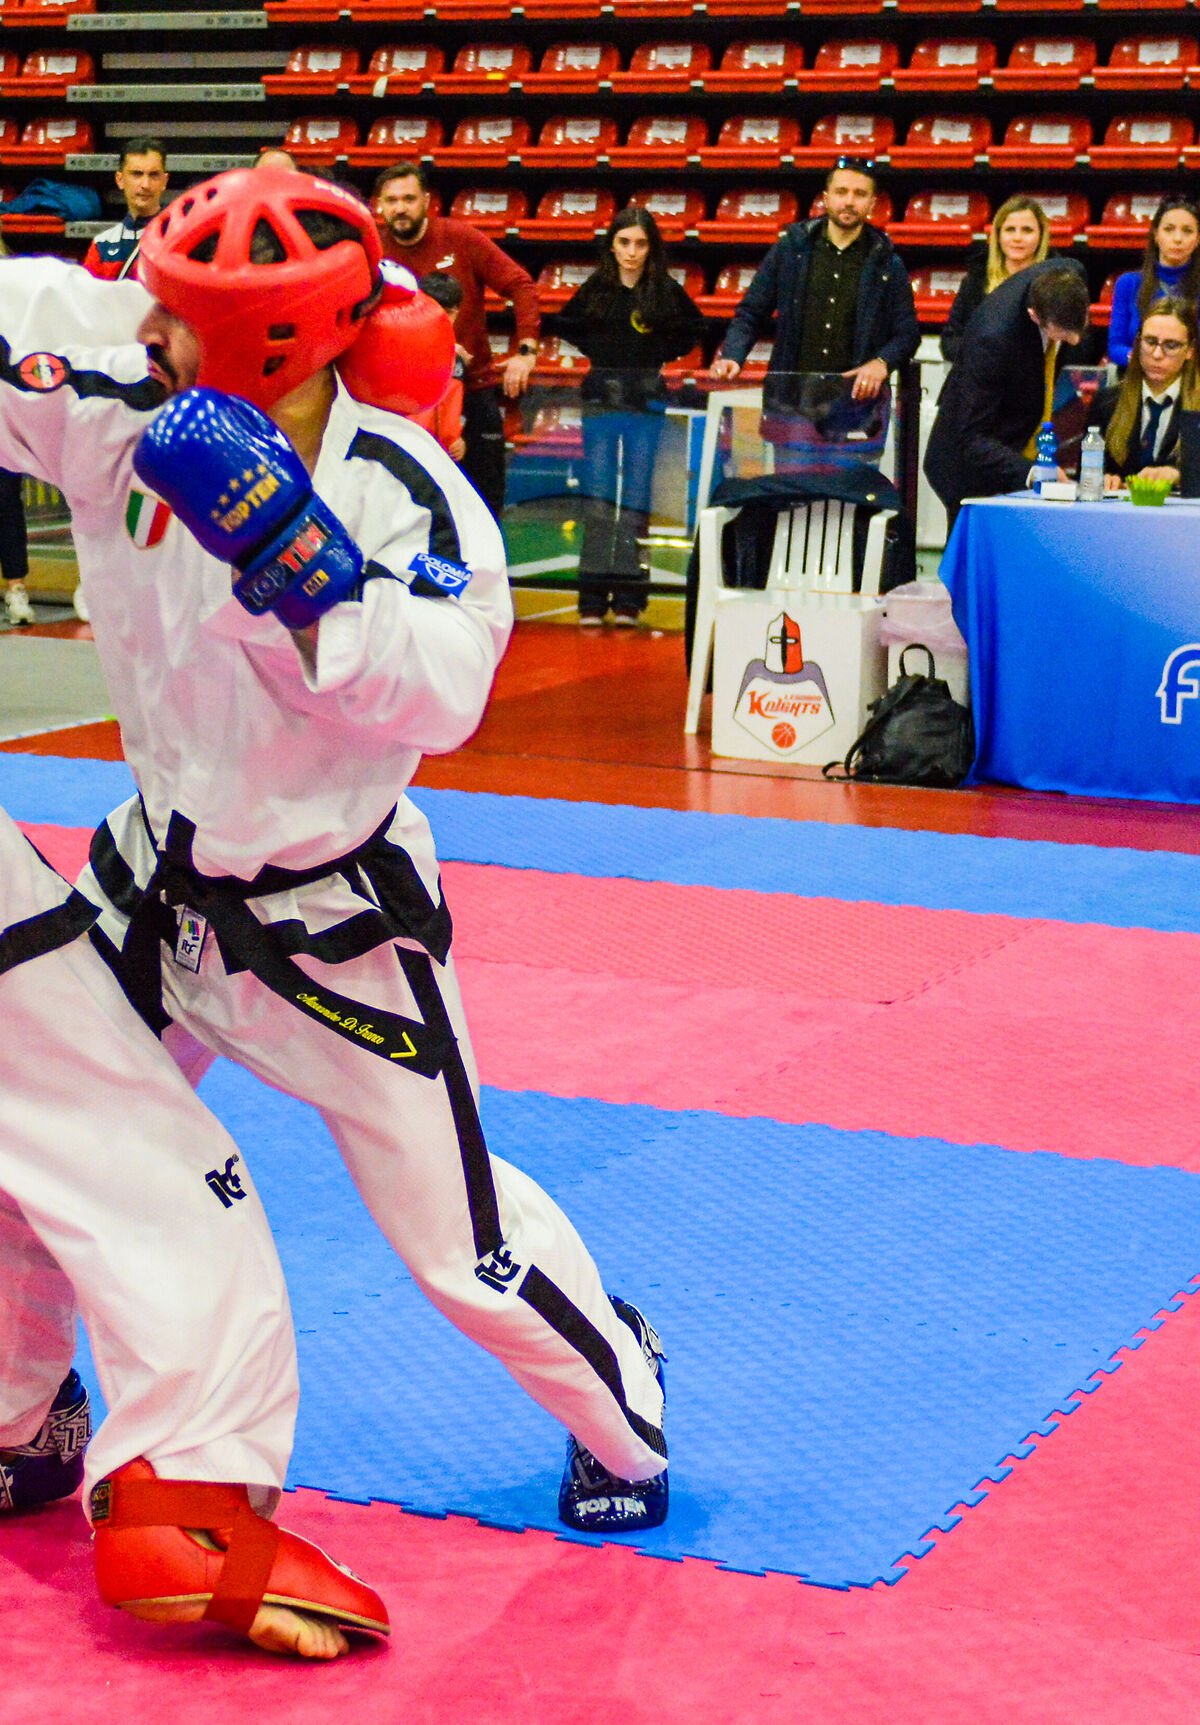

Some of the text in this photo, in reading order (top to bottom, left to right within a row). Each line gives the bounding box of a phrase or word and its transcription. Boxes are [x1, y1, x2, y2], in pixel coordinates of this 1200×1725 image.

[219, 472, 282, 532] TOP TEN
[276, 522, 328, 574] TEN
[576, 1496, 648, 1516] TOP TEN
